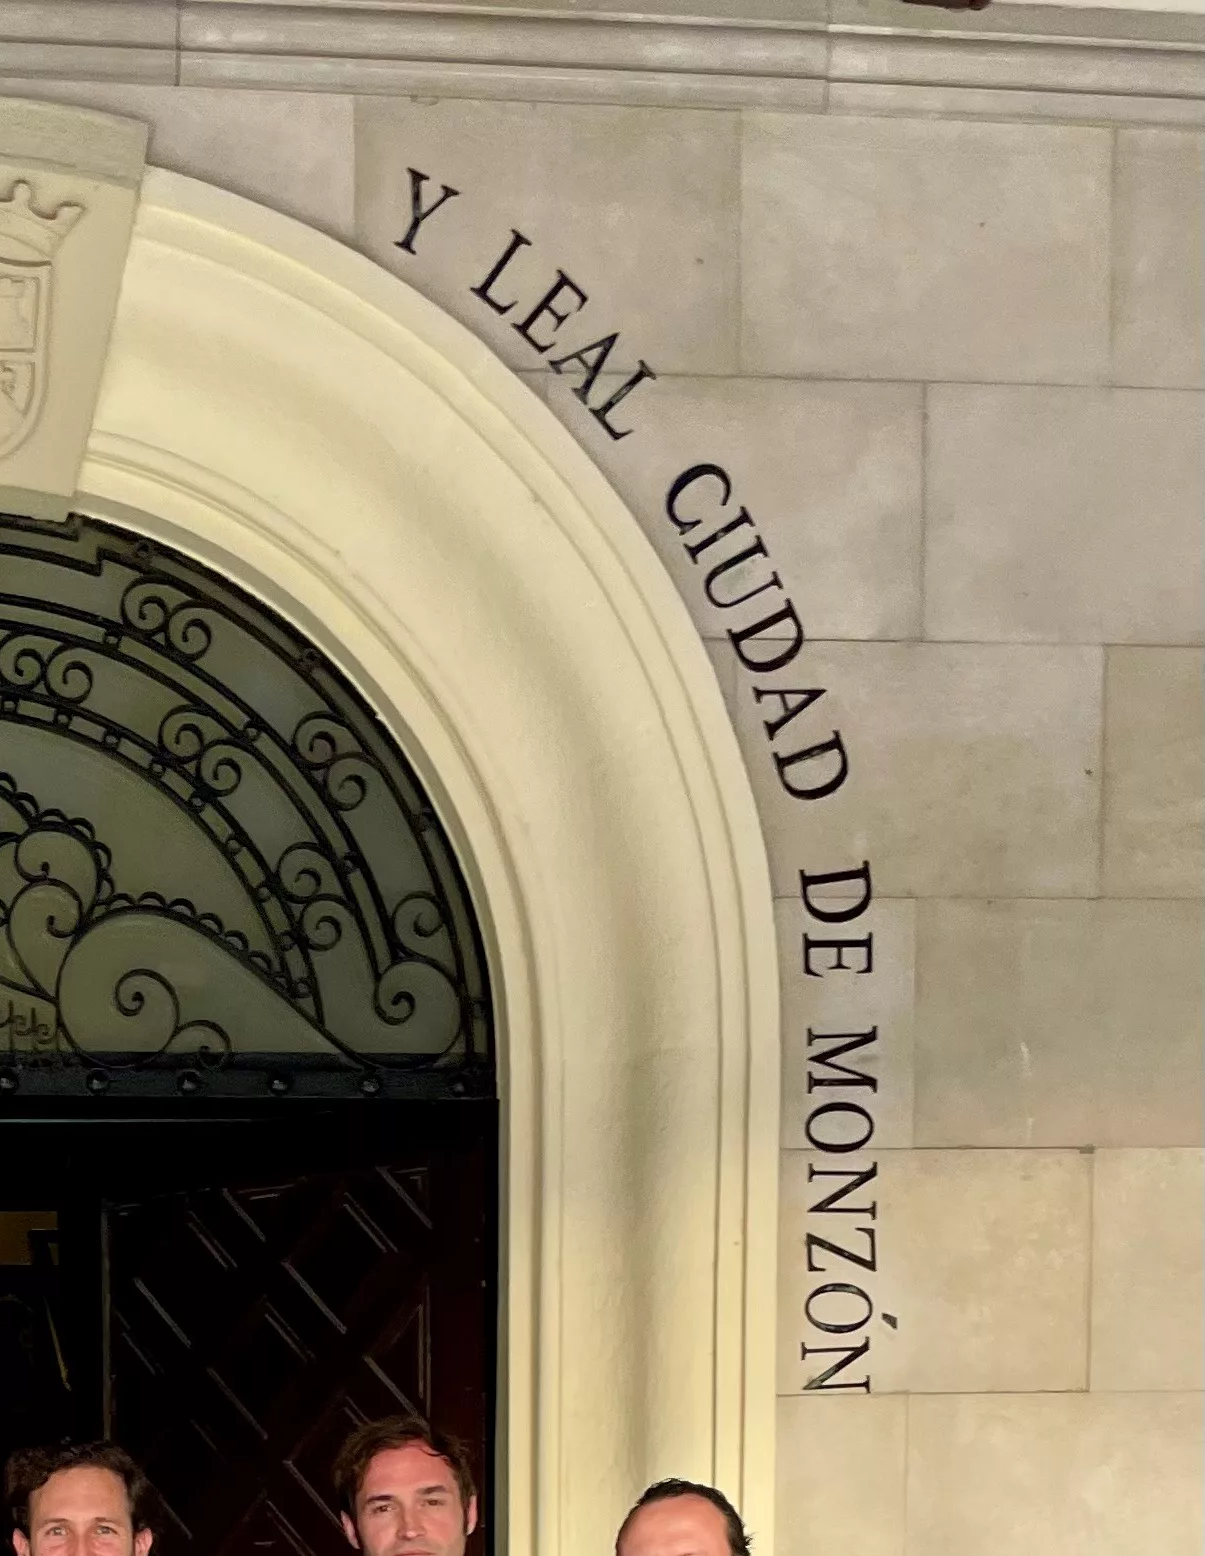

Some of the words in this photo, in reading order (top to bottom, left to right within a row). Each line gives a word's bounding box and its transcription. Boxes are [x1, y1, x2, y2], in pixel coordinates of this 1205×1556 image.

[393, 167, 460, 255] Y
[469, 228, 657, 441] LEAL
[665, 463, 850, 801] CIUDAD
[799, 860, 874, 978] DE
[801, 1025, 898, 1394] MONZÓN
